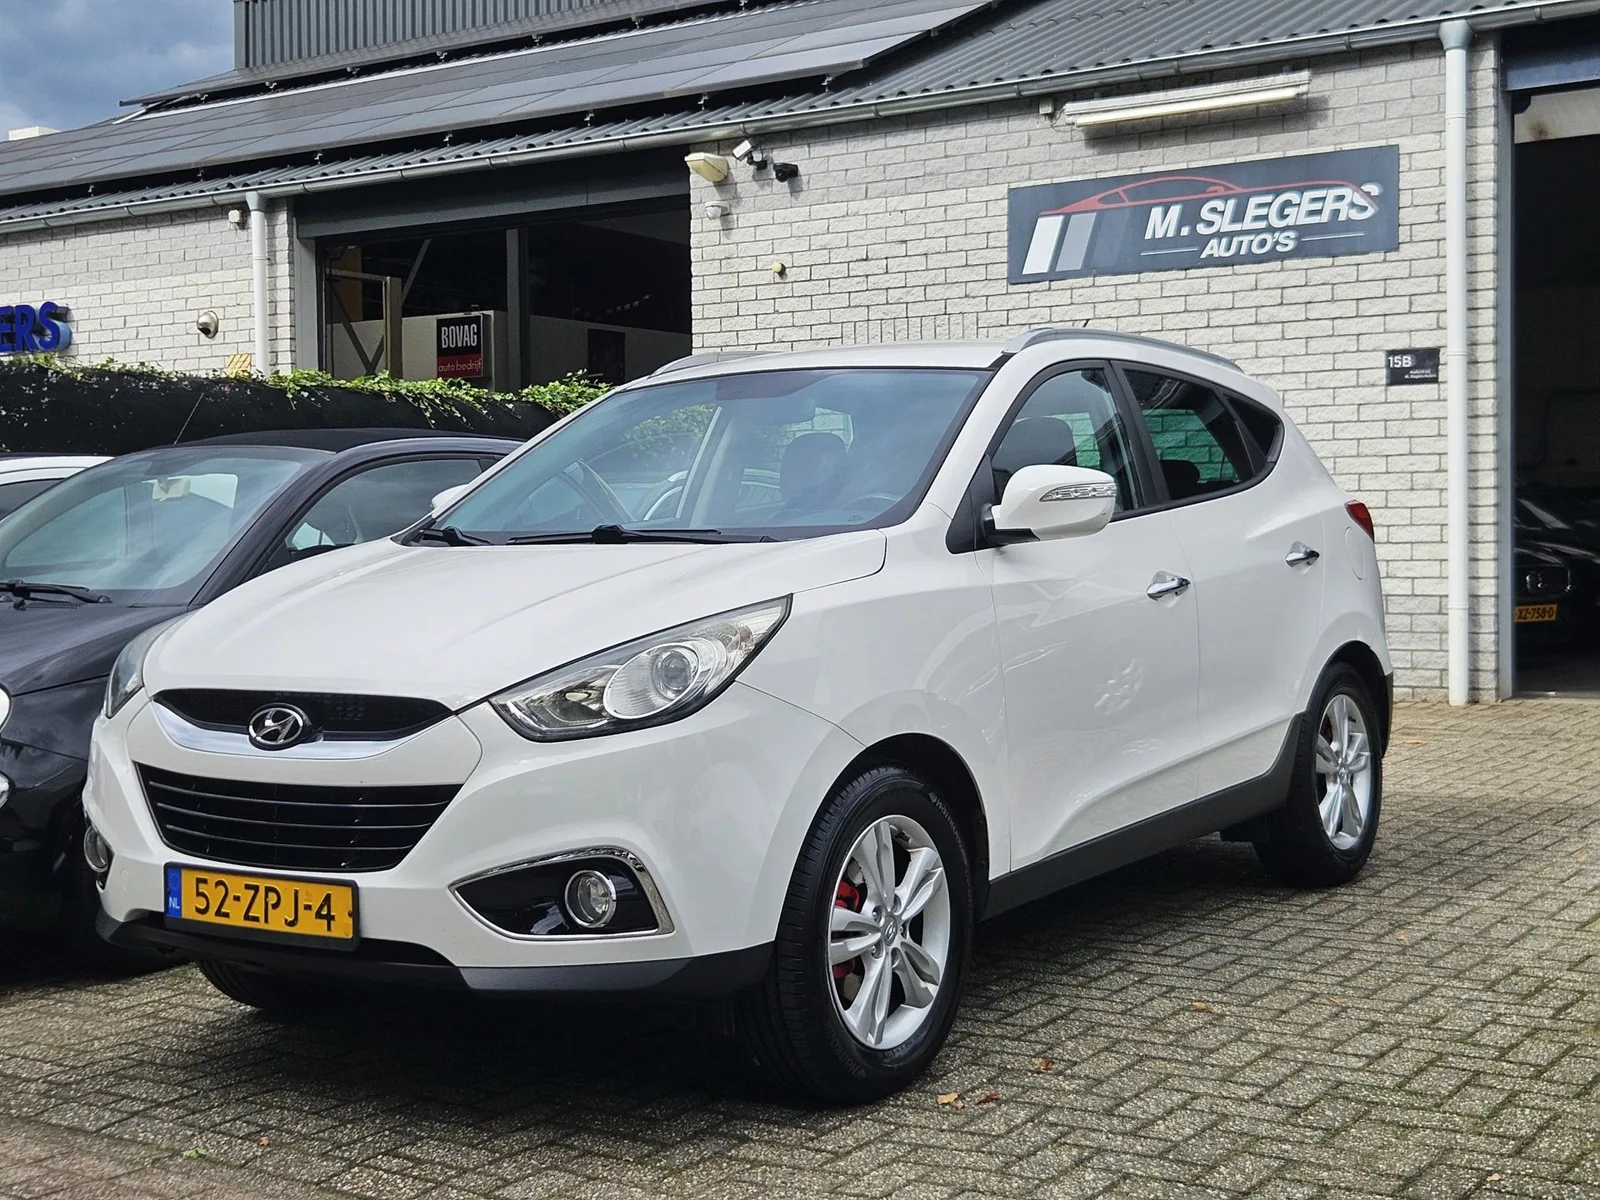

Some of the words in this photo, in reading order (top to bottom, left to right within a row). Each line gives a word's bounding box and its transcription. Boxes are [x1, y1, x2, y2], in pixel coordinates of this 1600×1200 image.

[1144, 203, 1191, 240] M.
[1196, 182, 1383, 235] SLEGERS
[1200, 230, 1299, 259] AUTO'S
[441, 324, 477, 348] BOVAG
[1388, 354, 1412, 368] 15B
[1517, 606, 1554, 620] XZ-758-D
[168, 896, 180, 909] NL
[194, 876, 336, 932] 52-ZPJ-4
